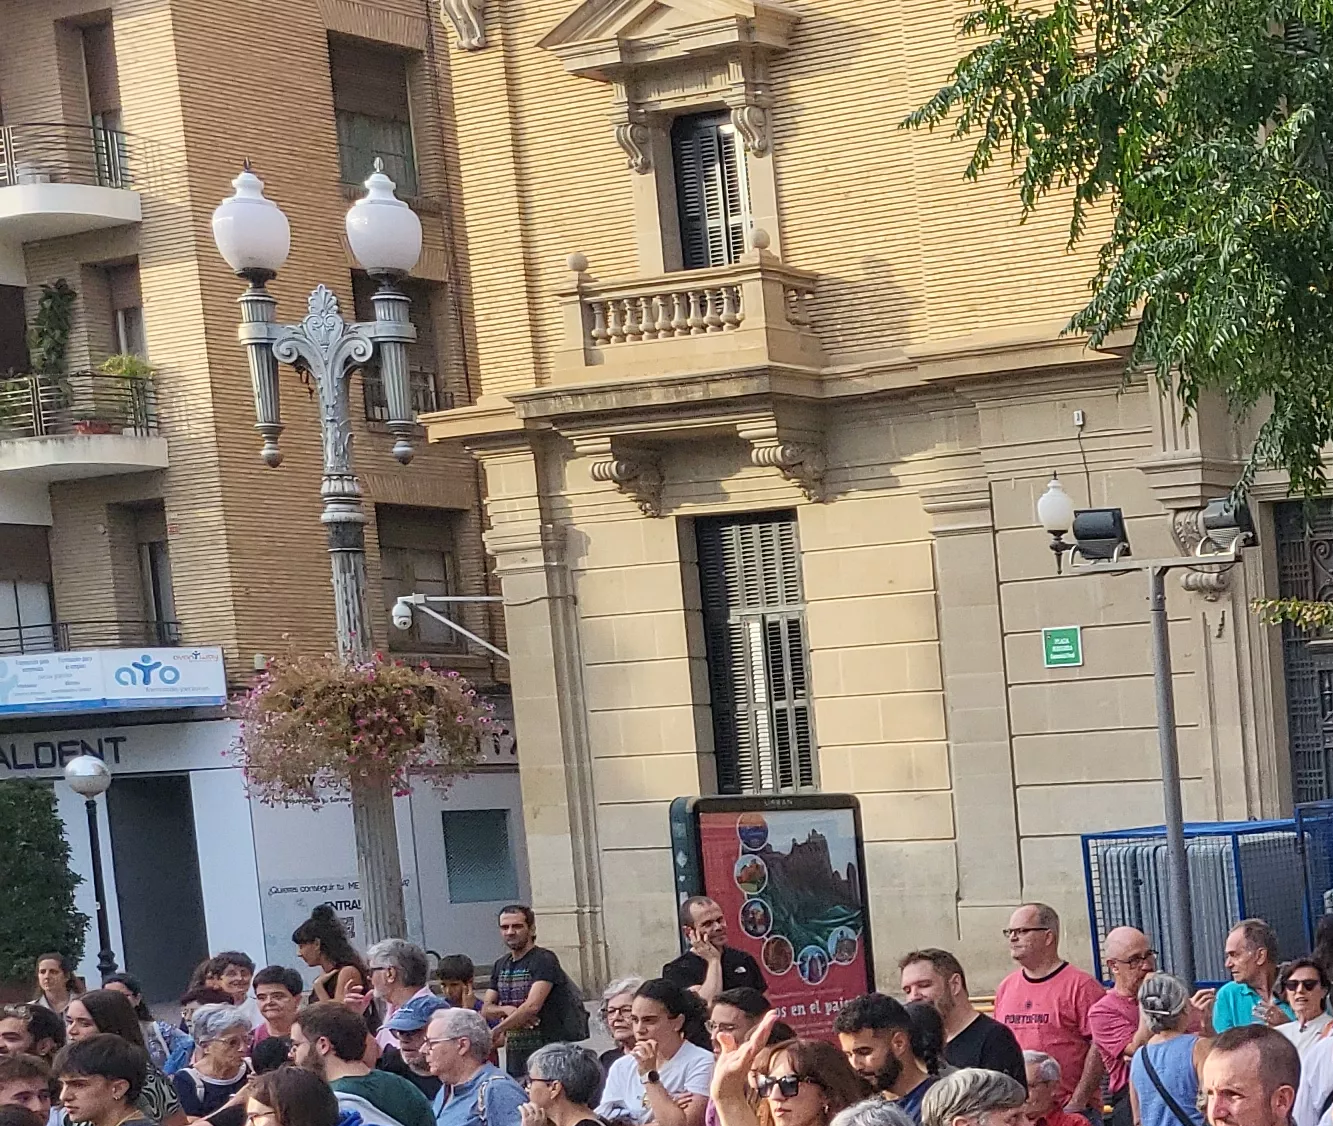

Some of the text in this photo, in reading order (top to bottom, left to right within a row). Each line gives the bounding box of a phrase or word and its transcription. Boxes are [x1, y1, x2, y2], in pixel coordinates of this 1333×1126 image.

[775, 1006, 787, 1018] os
[791, 1004, 806, 1016] en
[809, 999, 822, 1014] el
